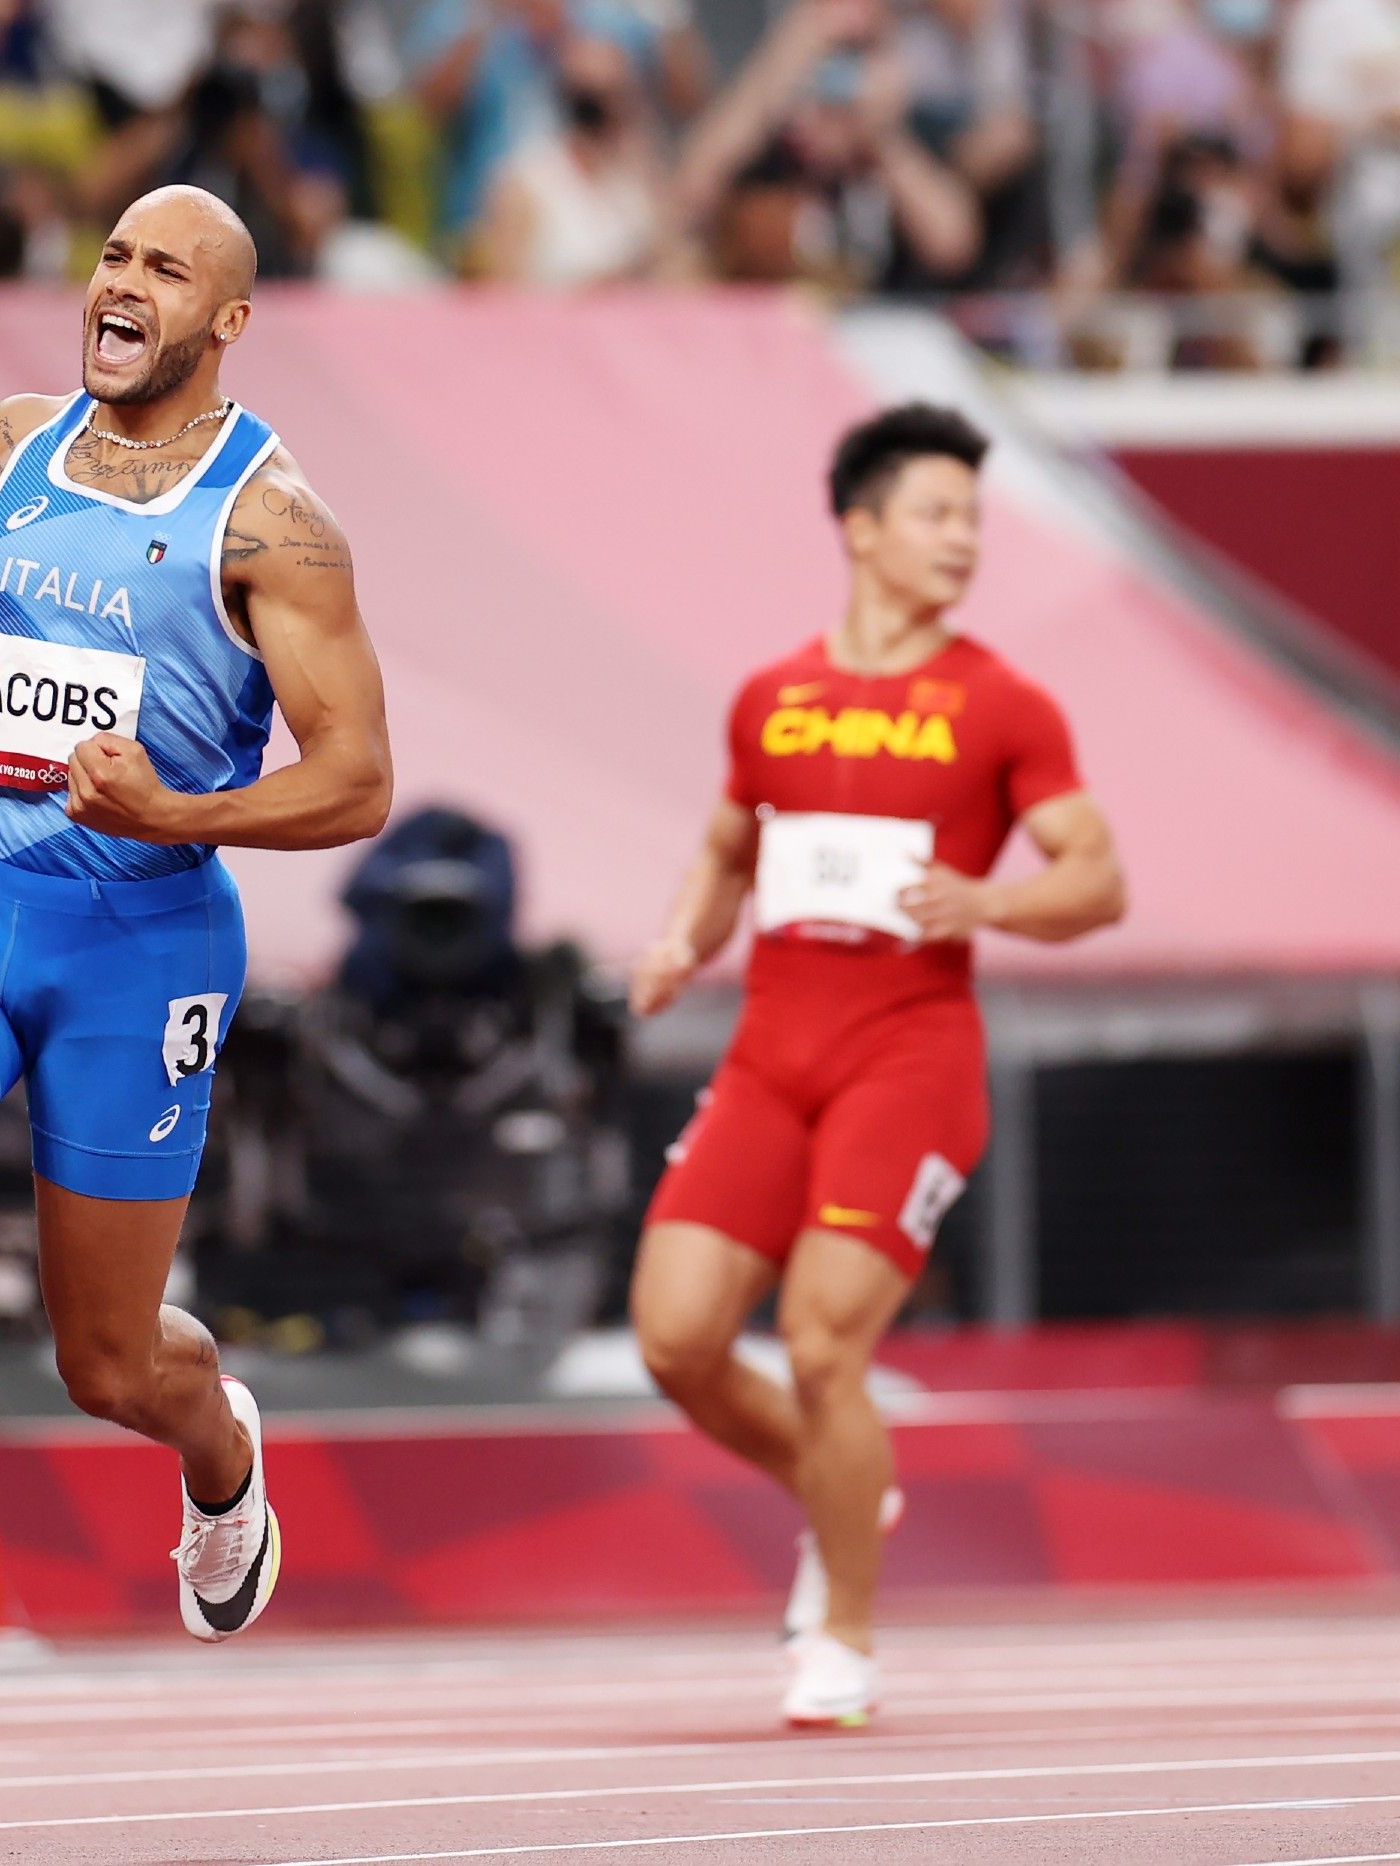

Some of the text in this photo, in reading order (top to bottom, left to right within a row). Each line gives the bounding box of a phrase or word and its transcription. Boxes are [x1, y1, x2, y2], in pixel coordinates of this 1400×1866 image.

[0, 557, 133, 629] ITALIA
[761, 707, 957, 763] CHINA
[14, 767, 36, 780] 2020
[176, 1004, 208, 1076] 3
